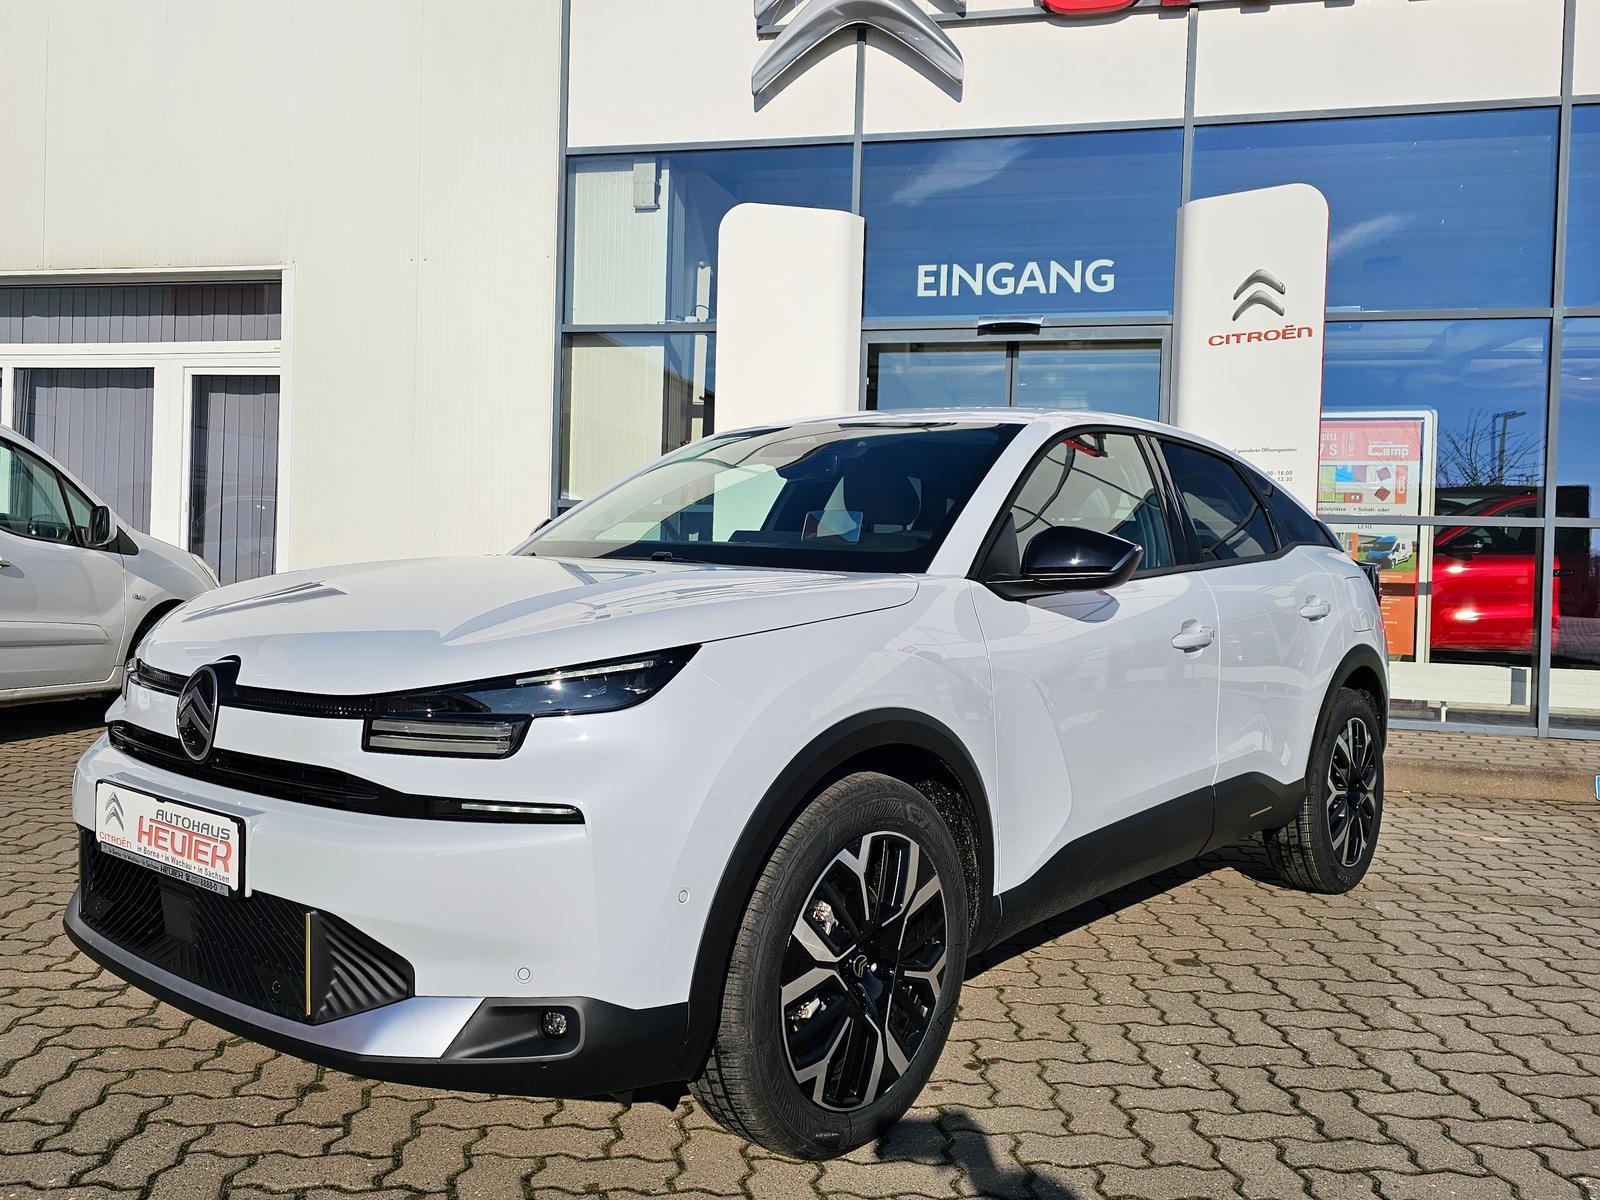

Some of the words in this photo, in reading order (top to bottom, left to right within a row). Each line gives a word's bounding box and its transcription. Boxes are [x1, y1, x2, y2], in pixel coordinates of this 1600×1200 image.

[917, 259, 1115, 297] EINGANG
[1329, 443, 1338, 456] S
[137, 815, 232, 873] HEUTER
[155, 809, 231, 841] AUTOHAUS
[143, 846, 160, 859] Borna
[170, 855, 192, 871] Wachau
[197, 865, 203, 873] in
[204, 867, 230, 884] Sachsen
